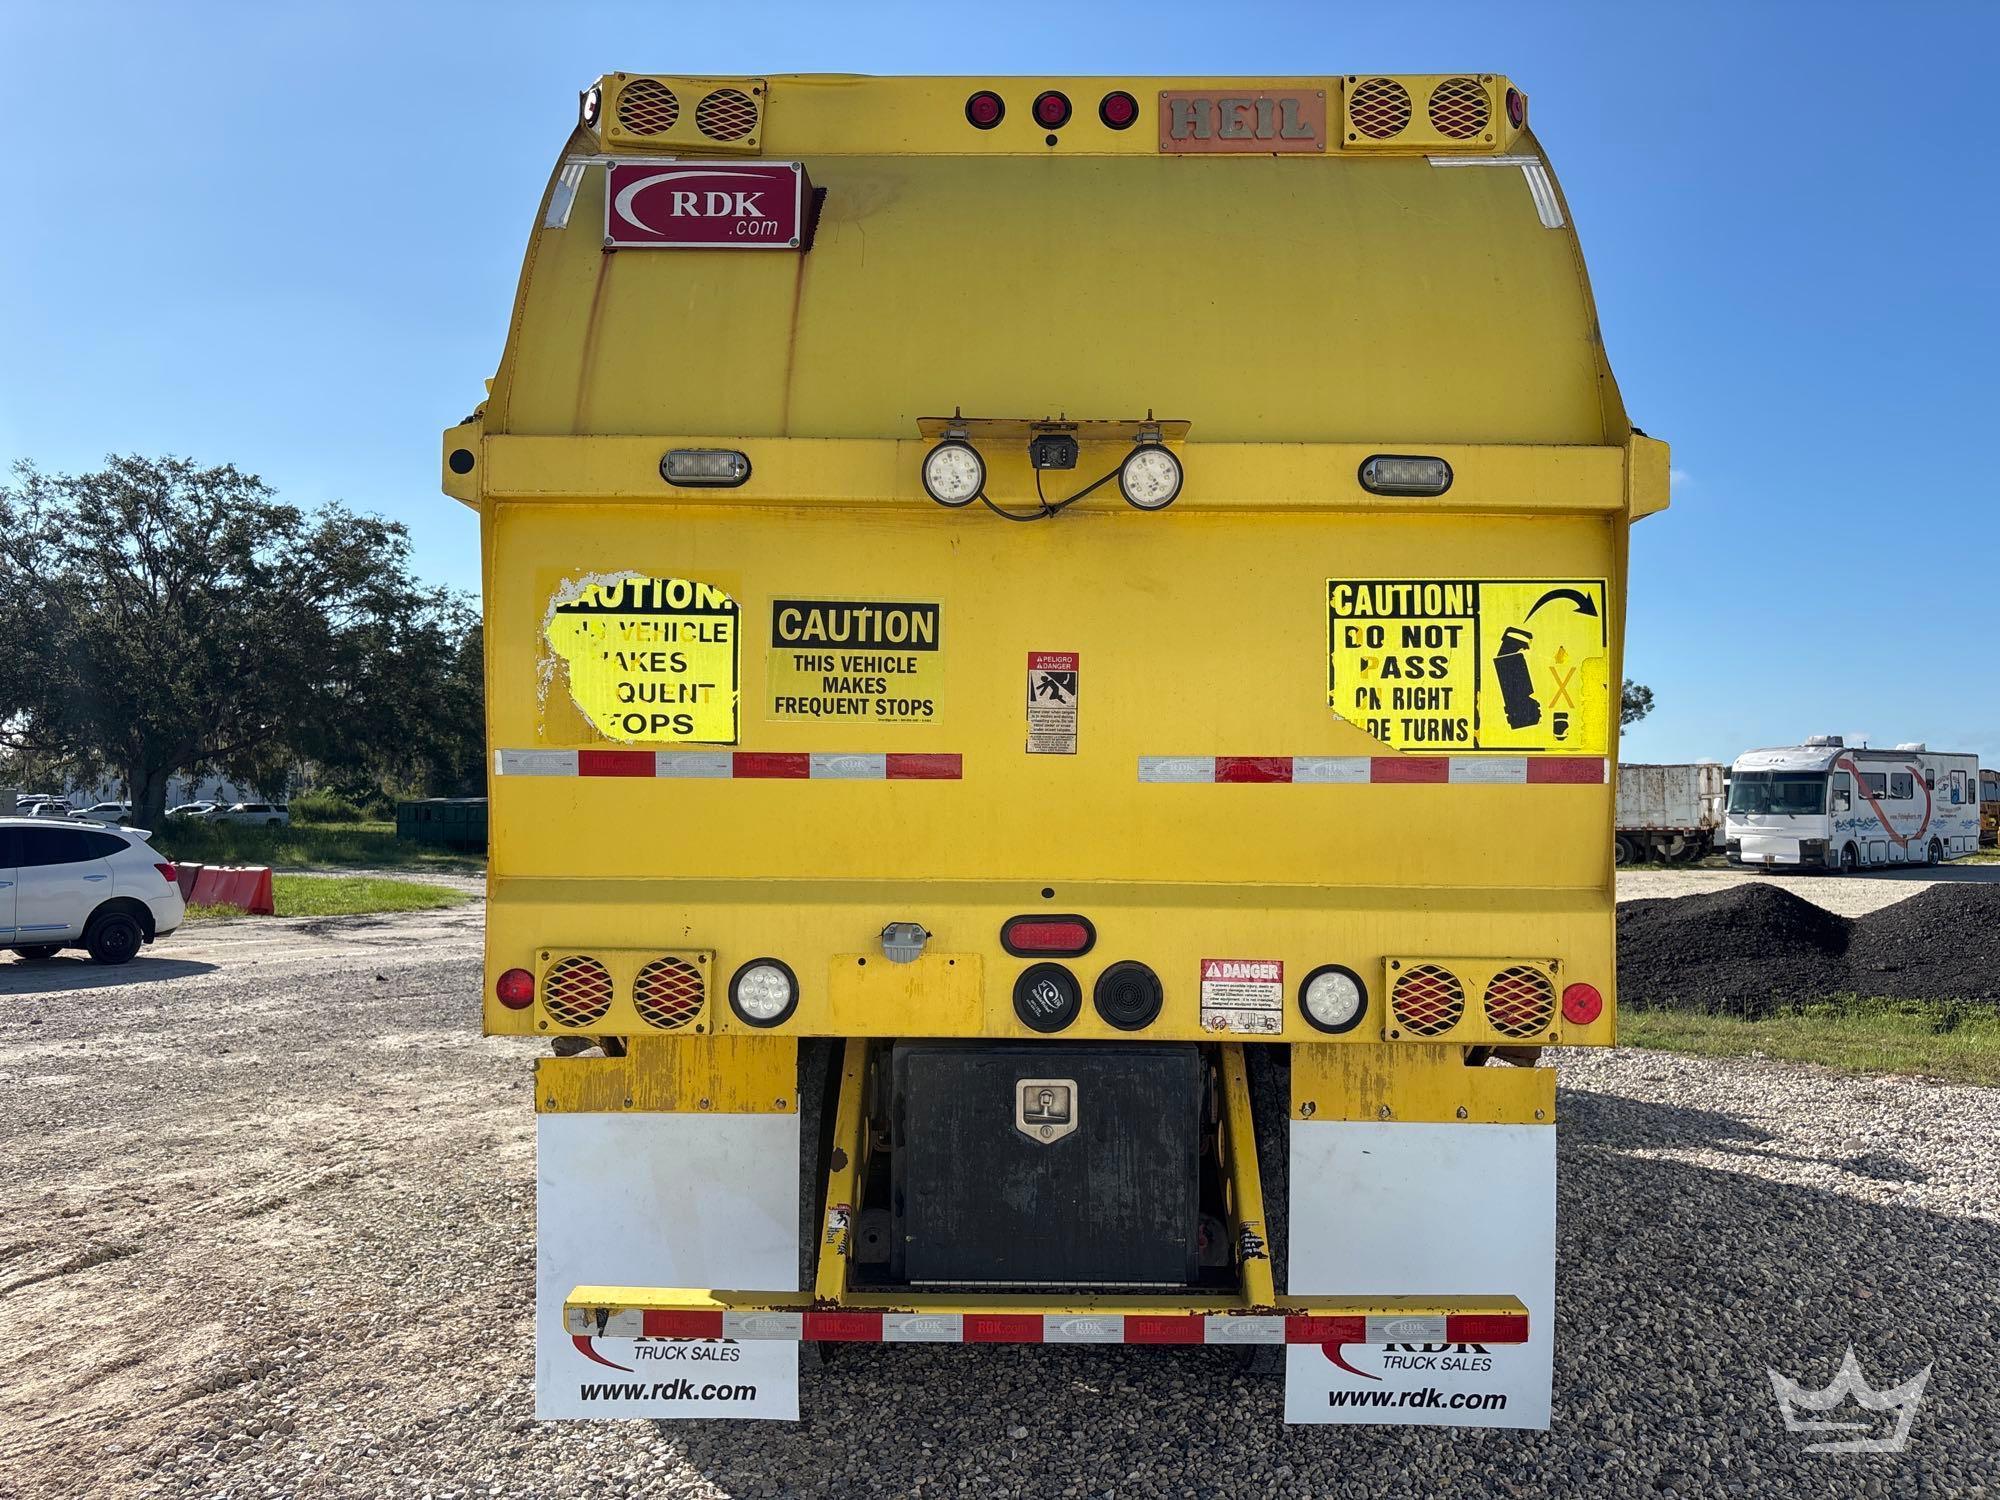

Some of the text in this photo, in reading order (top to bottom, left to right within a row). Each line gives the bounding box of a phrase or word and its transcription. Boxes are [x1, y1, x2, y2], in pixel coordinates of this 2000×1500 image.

[1170, 98, 1315, 140] HEIL
[670, 191, 766, 217] RDK
[729, 220, 778, 236] .com
[1334, 584, 1474, 616] CAUTION!
[778, 607, 934, 643] CAUTION
[1345, 625, 1463, 649] DO NOT
[604, 651, 688, 673] AKES
[793, 654, 917, 674] THIS VEHICLE
[1360, 655, 1448, 679] PASS
[823, 676, 887, 694] MAKES
[775, 696, 934, 717] FREQUENT STOPS
[1393, 687, 1453, 710] RIGHT
[1401, 718, 1469, 742] TURNS
[1223, 963, 1278, 979] DANGER
[634, 1346, 740, 1361] TRUCK SALES
[1382, 1355, 1492, 1371] TRUCK SALES
[580, 1378, 756, 1401] www.rdk.com
[1328, 1387, 1507, 1410] www.rdk.com
